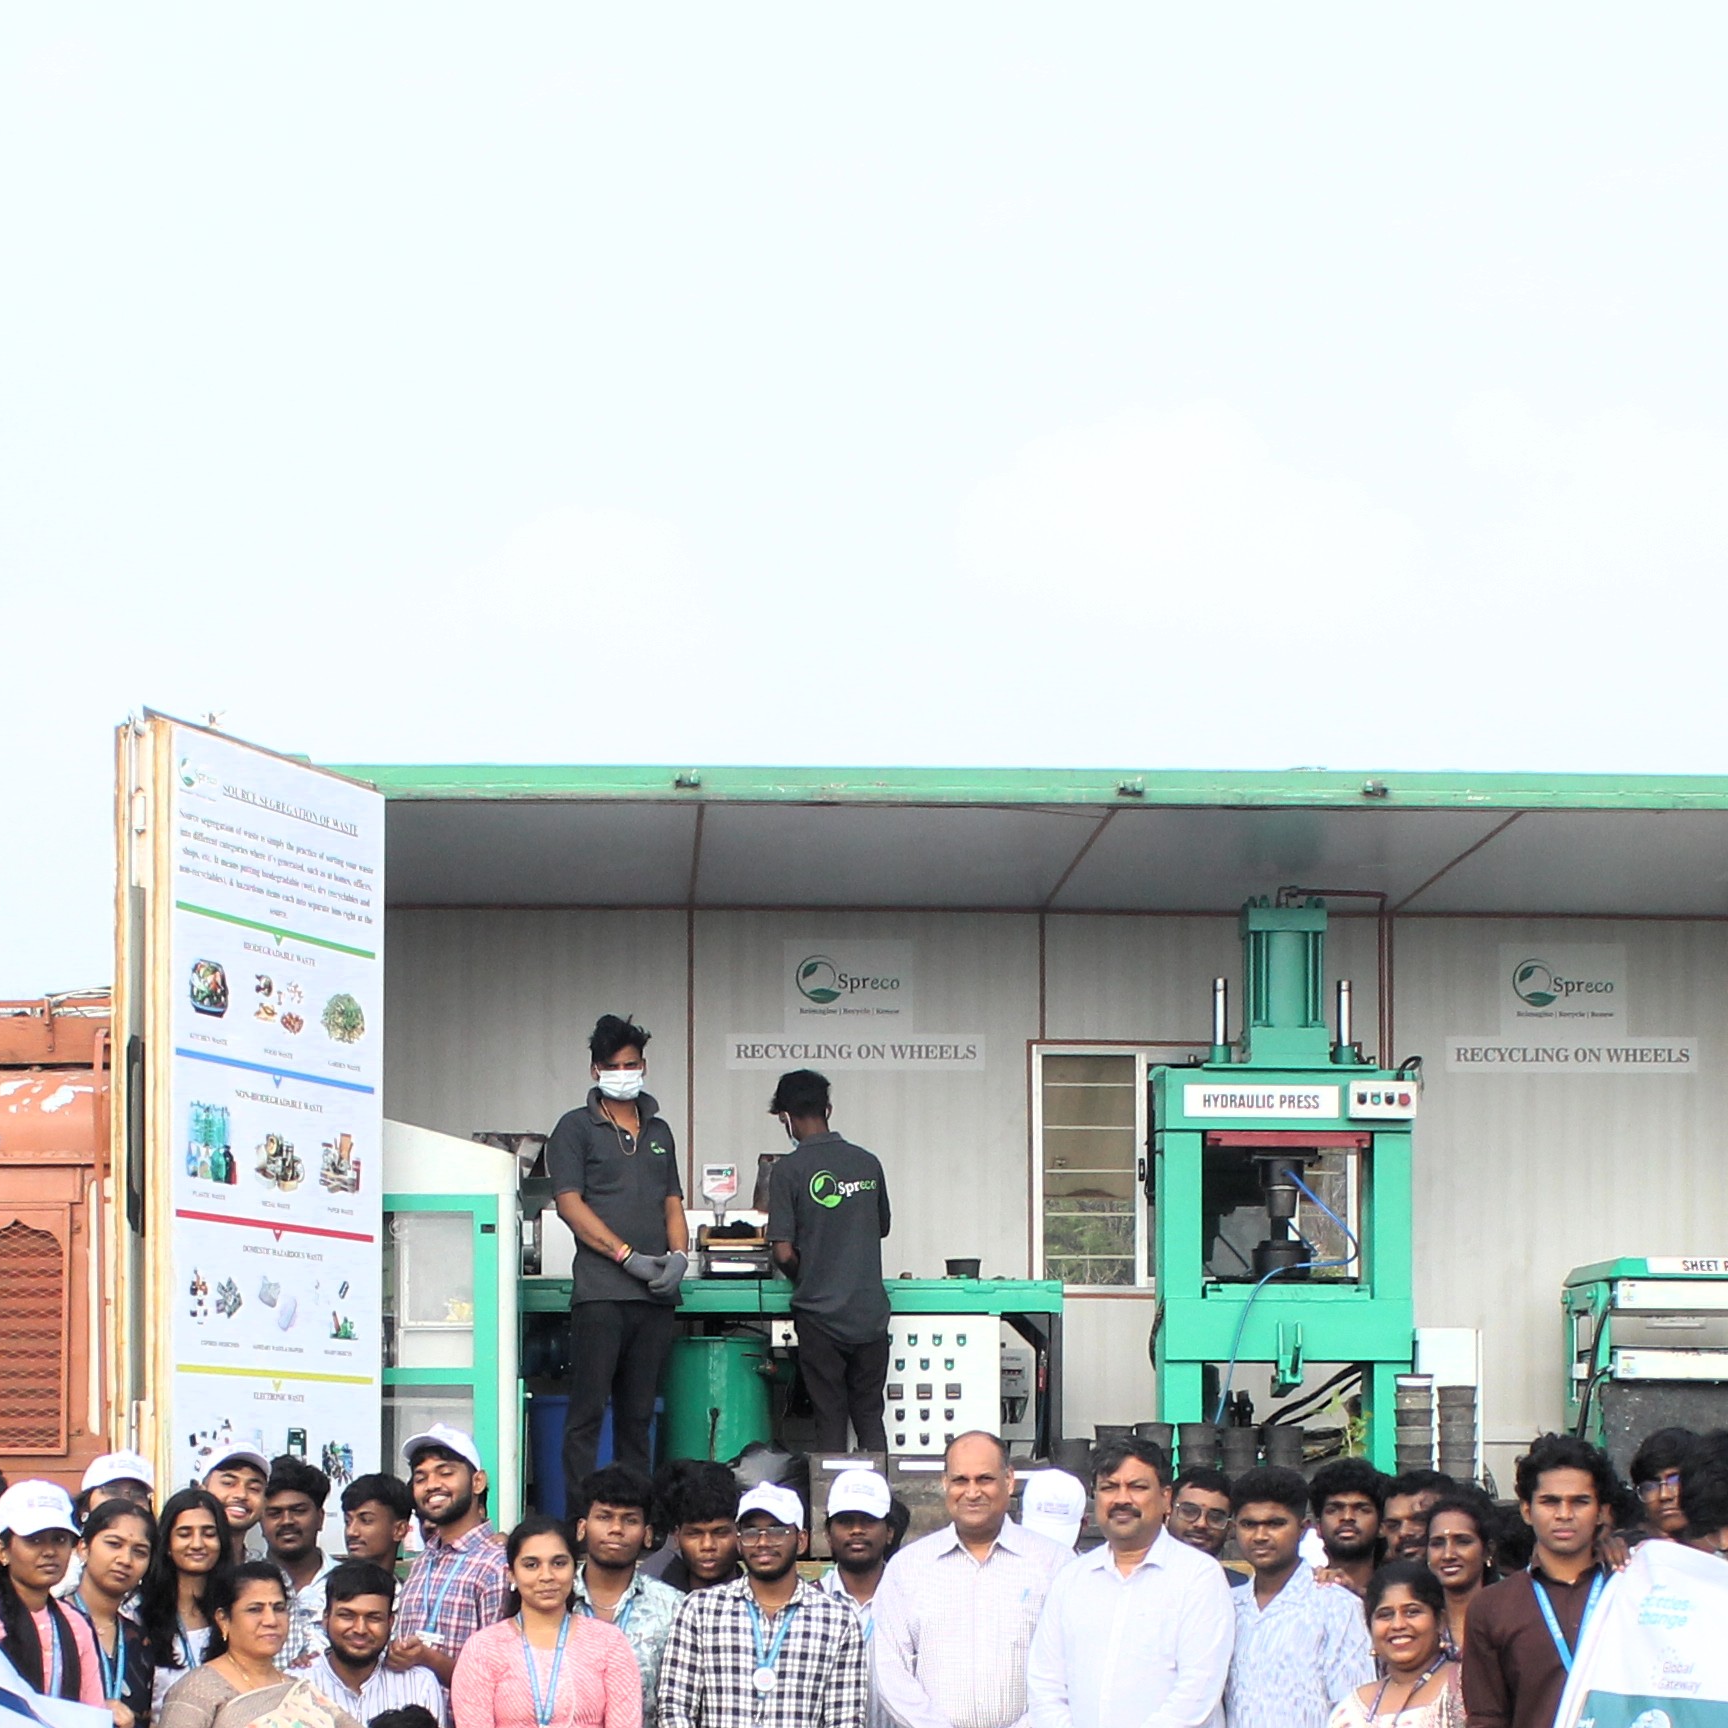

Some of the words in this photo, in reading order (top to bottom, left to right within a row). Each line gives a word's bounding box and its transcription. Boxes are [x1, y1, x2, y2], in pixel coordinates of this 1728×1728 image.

[222, 785, 257, 804] SOURCE
[259, 796, 318, 824] SEGREGATION
[319, 814, 331, 827] OF
[332, 818, 359, 836] WASTE
[243, 941, 295, 962] BIODEGRADABLE
[296, 954, 316, 967] WASTE
[838, 973, 900, 993] Spreco
[1553, 976, 1614, 997] Spreco
[735, 1043, 852, 1060] RECYCLING
[857, 1044, 885, 1060] ON
[890, 1044, 977, 1060] WHEELS
[1455, 1047, 1569, 1063] RECYCLING
[1574, 1047, 1602, 1063] ON
[1606, 1047, 1690, 1063] WHEELS
[235, 1089, 302, 1109] NON-BIODEGRADABLE
[303, 1100, 323, 1113] WASTE
[1202, 1093, 1275, 1109] HYDRAULIC
[1279, 1094, 1320, 1110] PRESS
[837, 1178, 878, 1199] Spreco
[243, 1244, 270, 1256] DOMESTIC
[271, 1247, 305, 1260] HAZARDOUS
[306, 1252, 323, 1262] WASTE
[1682, 1259, 1719, 1273] SHEET
[254, 1391, 286, 1402] ELECTRONIC
[287, 1393, 304, 1403] WASTE
[1663, 1661, 1695, 1674] Global
[1658, 1677, 1703, 1694] Gateway
